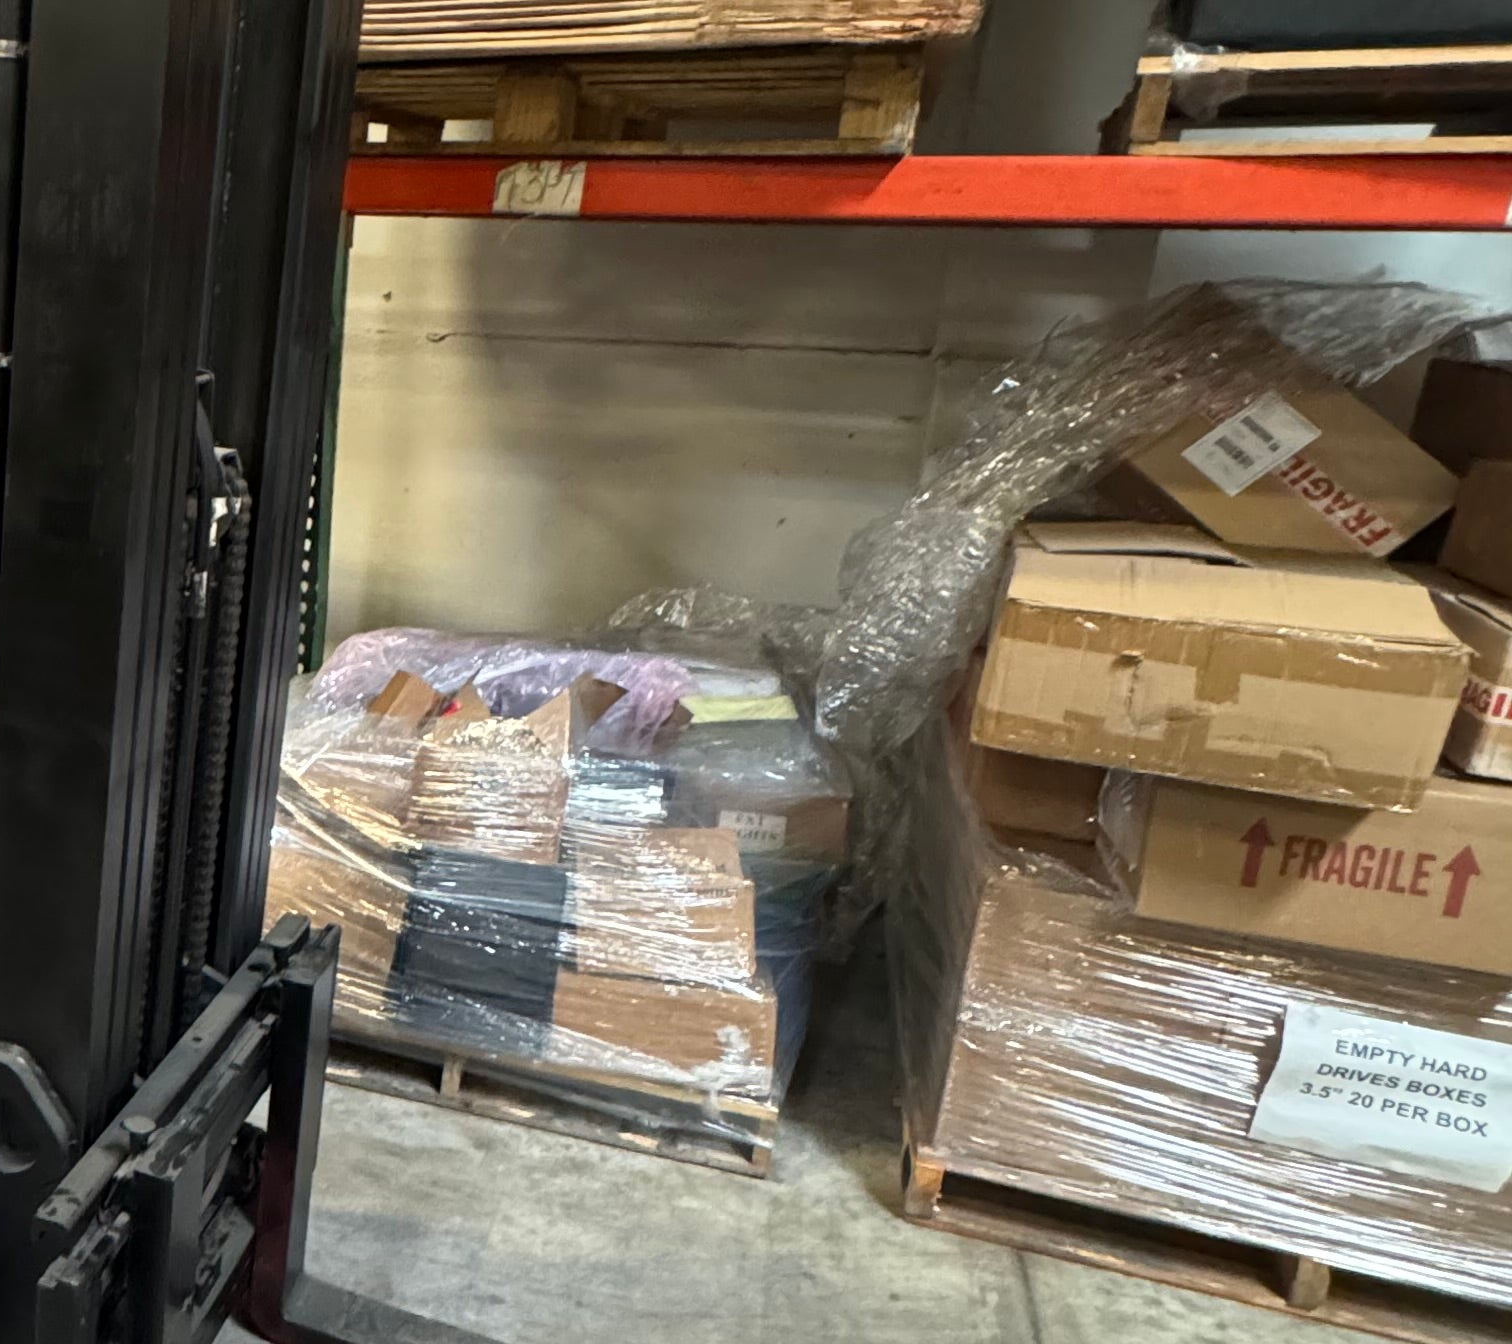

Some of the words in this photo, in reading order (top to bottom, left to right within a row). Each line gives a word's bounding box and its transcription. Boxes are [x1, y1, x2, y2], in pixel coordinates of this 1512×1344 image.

[1278, 455, 1393, 548] FRAGIL
[1278, 834, 1437, 898] FRAGILE
[1335, 1038, 1415, 1068] EMPTY
[1419, 1057, 1488, 1082] HARD
[1316, 1062, 1401, 1089] DRIVES
[1405, 1080, 1488, 1108] BOXES
[1347, 1091, 1375, 1109] 20
[1380, 1098, 1430, 1124] PER
[1434, 1111, 1489, 1138] BOX
